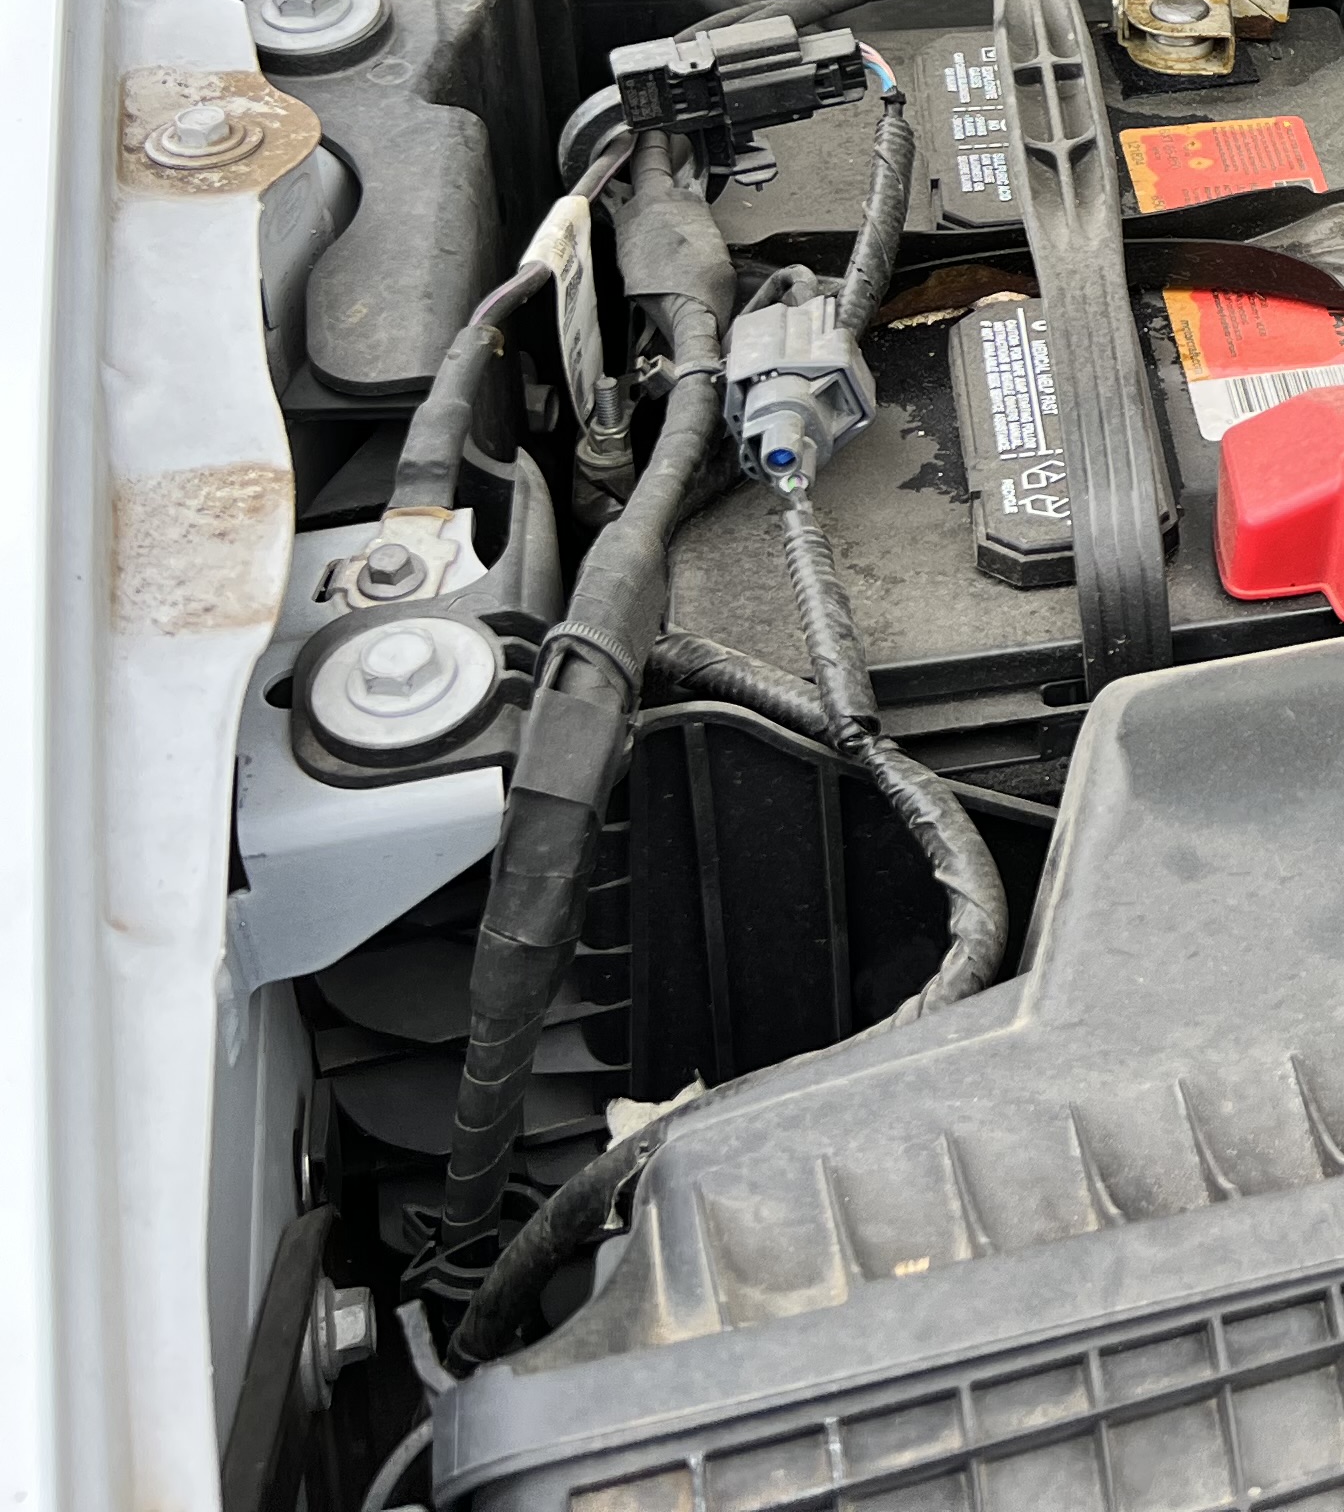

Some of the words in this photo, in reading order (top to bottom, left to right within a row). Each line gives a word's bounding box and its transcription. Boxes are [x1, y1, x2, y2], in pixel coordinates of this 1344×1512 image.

[1031, 340, 1051, 373] MEDICAL
[1036, 374, 1055, 393] HELP
[1040, 395, 1058, 415] FAST
[1000, 479, 1019, 514] RECYCLE
